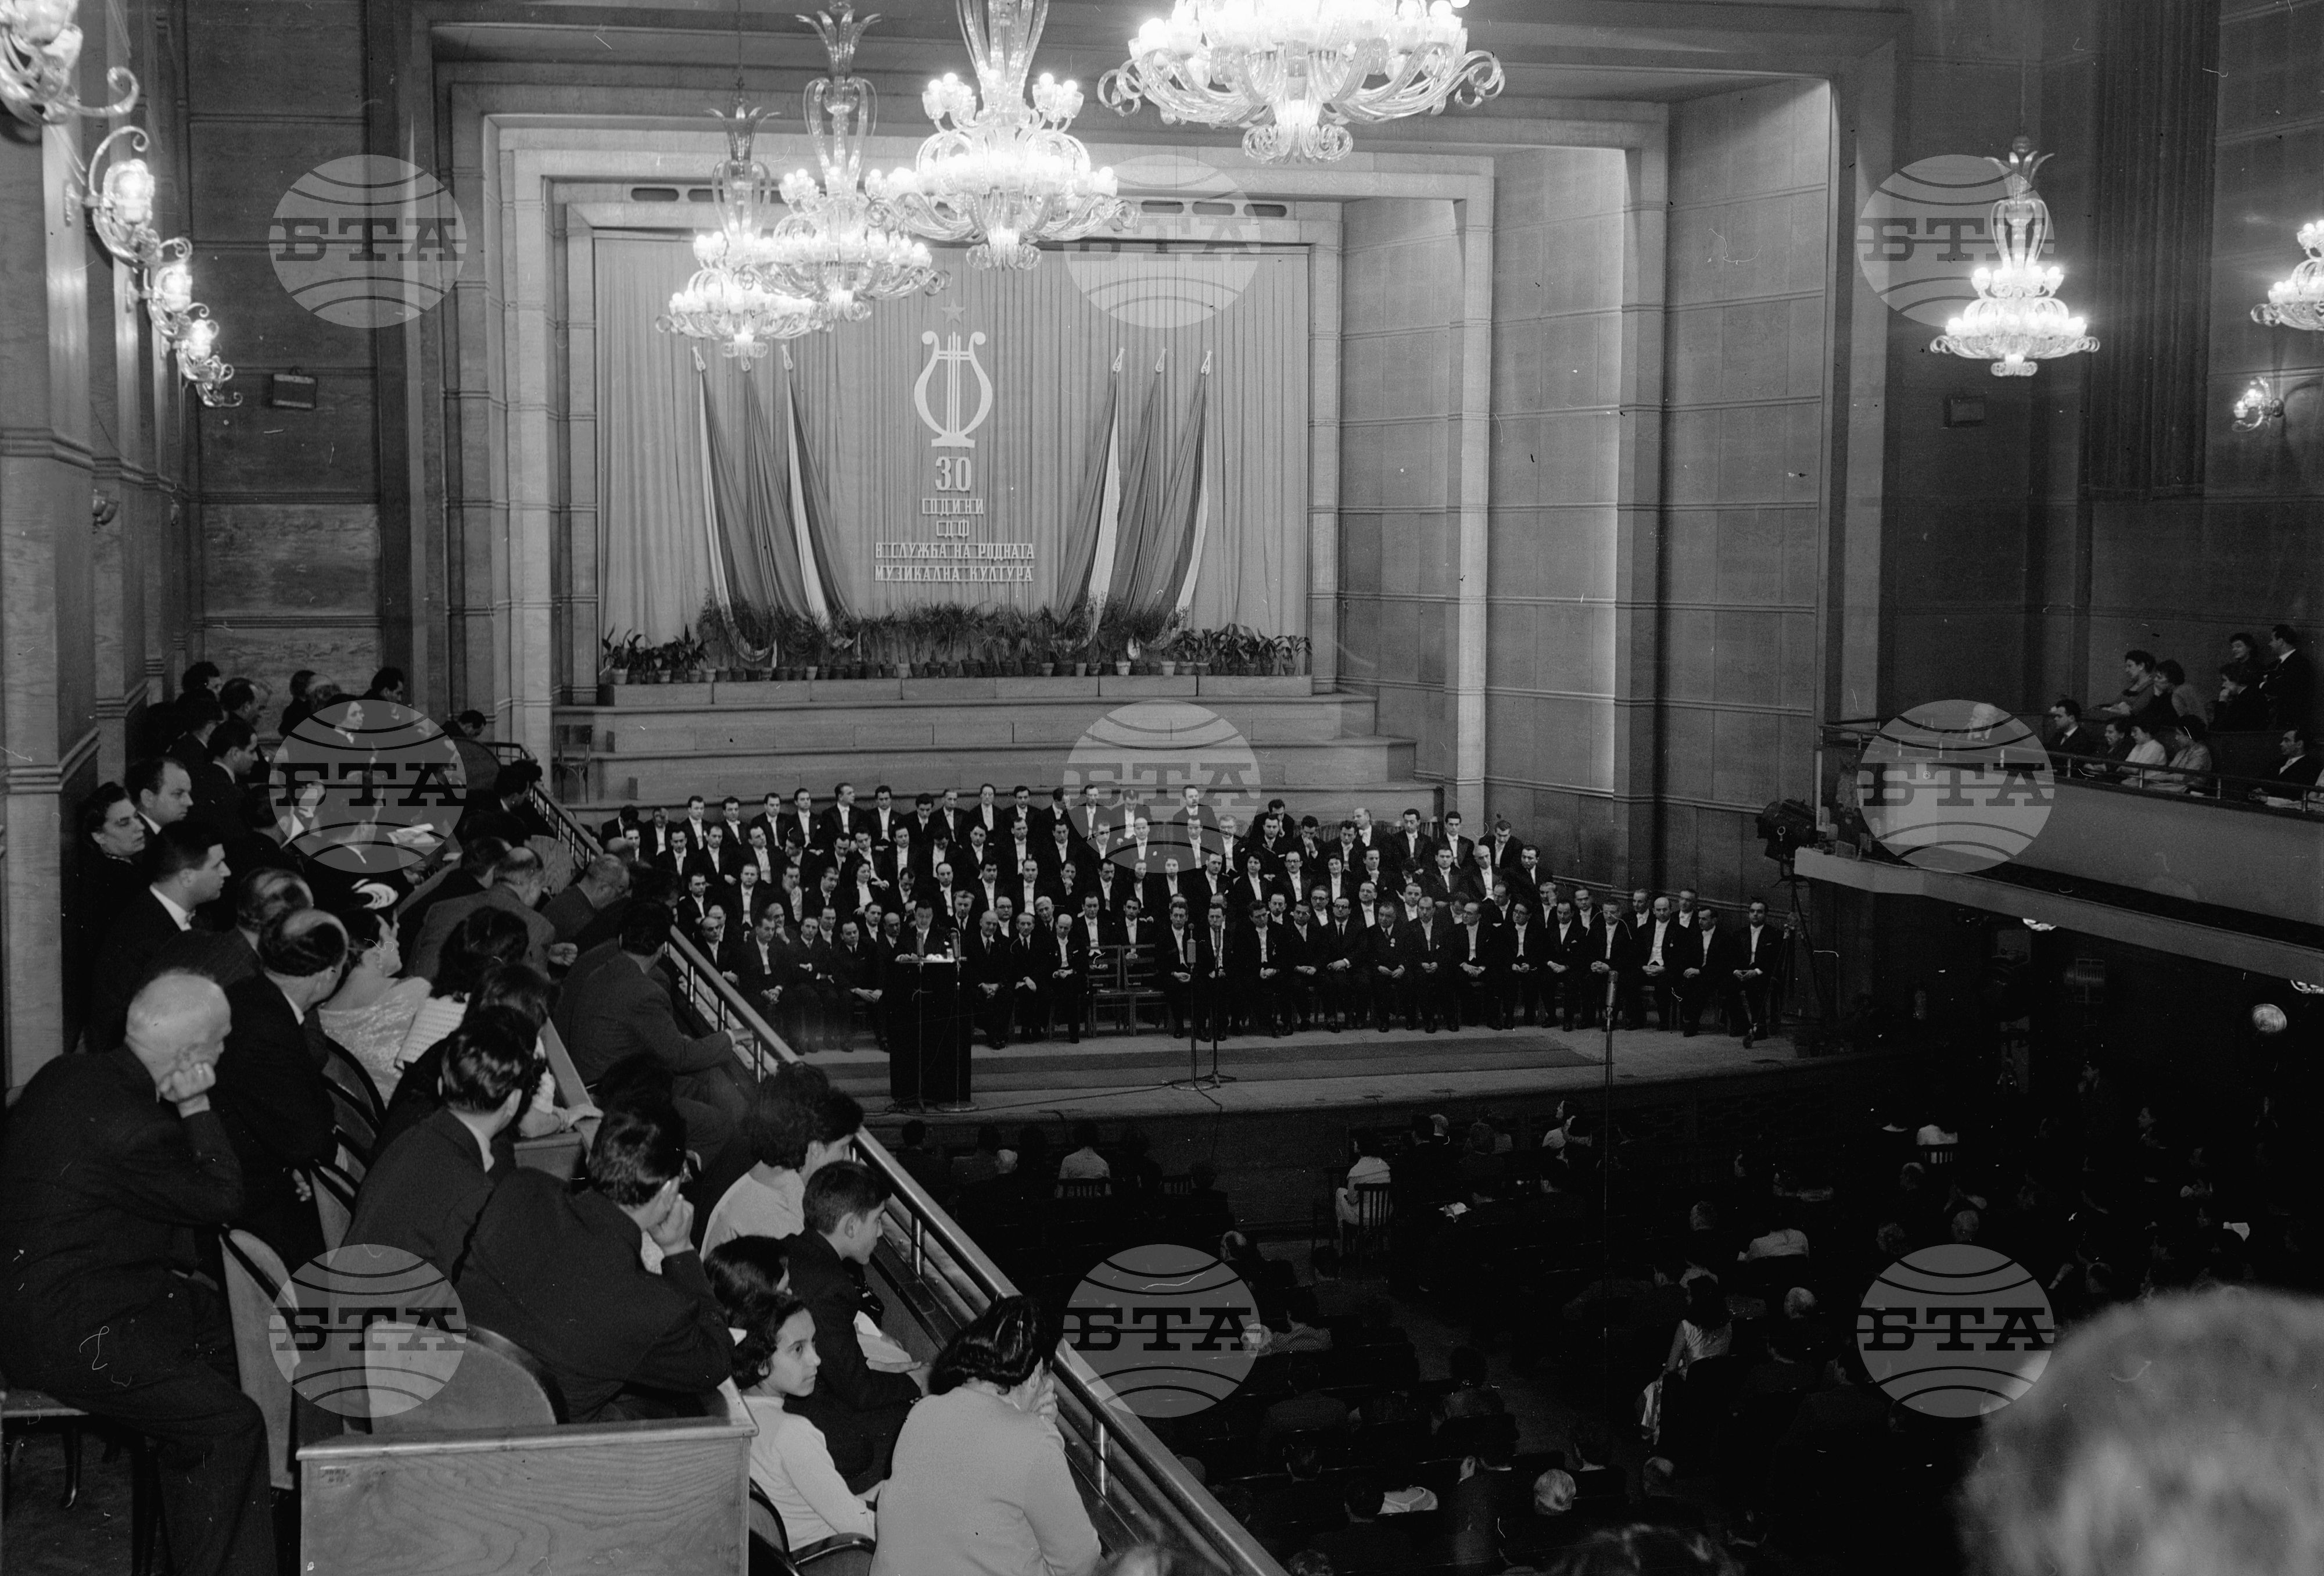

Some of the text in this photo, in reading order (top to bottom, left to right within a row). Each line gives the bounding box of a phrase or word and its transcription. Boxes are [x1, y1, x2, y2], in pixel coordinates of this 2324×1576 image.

[935, 457, 971, 492] 30
[922, 499, 984, 516] ГОДИНИ
[876, 543, 1034, 561] В СЛУЖБА НА РОДНАТА
[875, 565, 1033, 582] МУЗИКАЛНА КУЛТУРА
